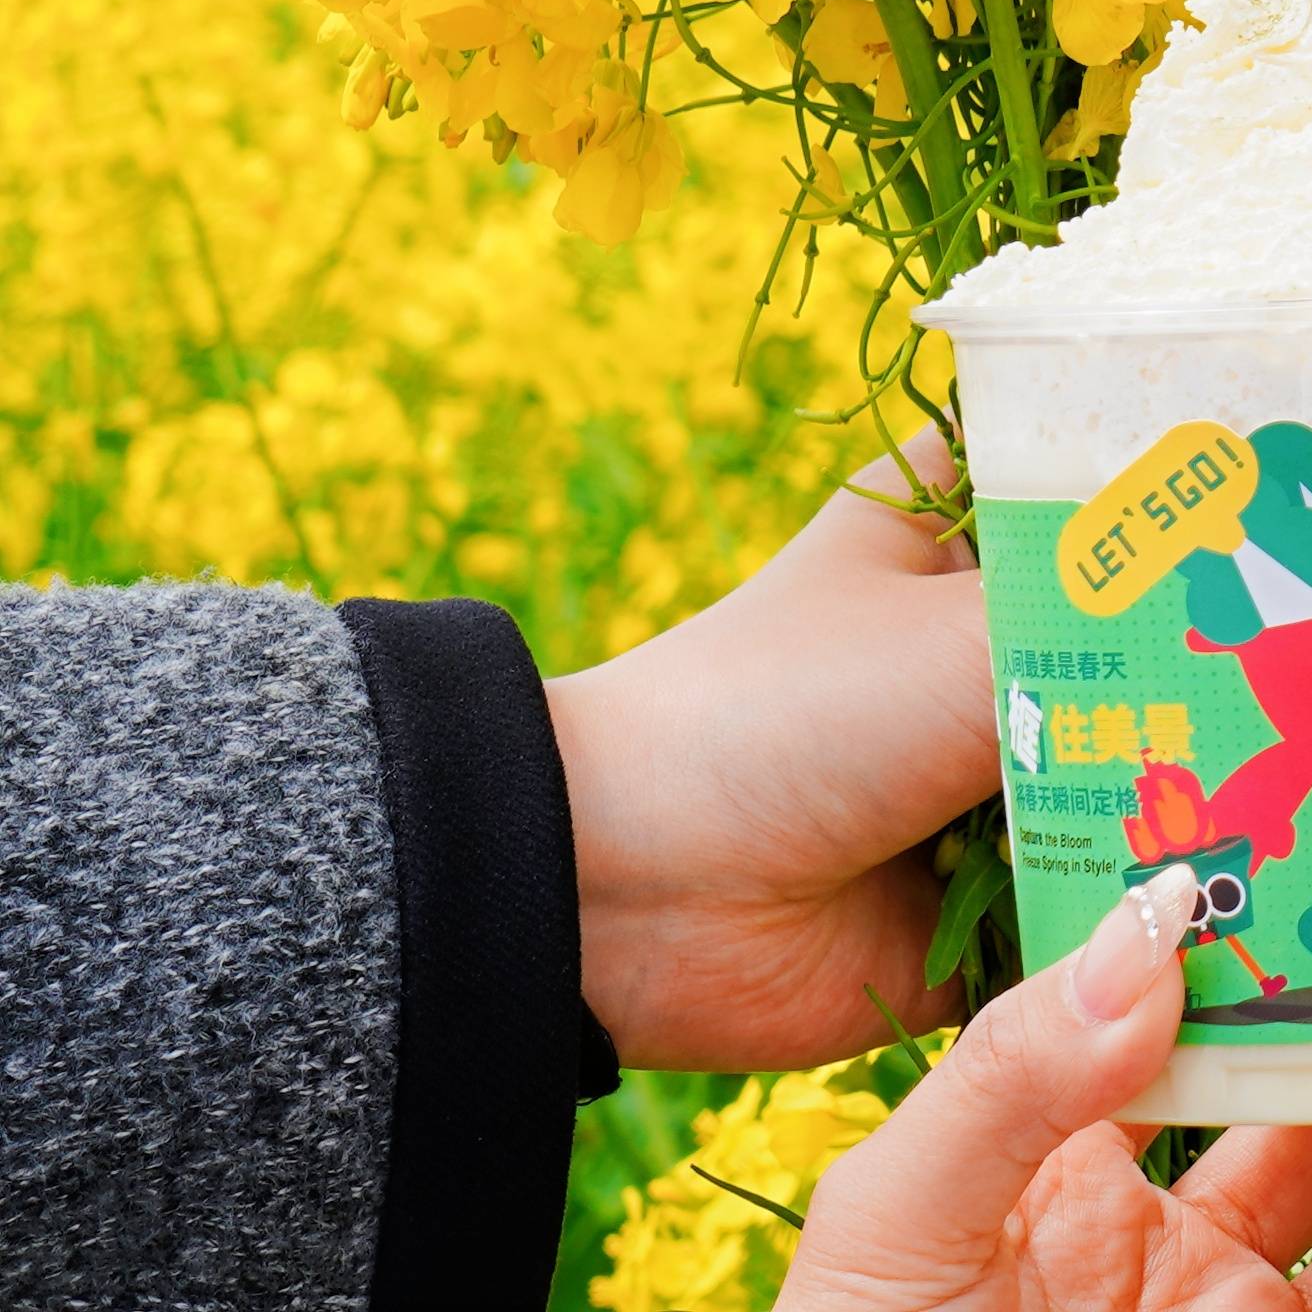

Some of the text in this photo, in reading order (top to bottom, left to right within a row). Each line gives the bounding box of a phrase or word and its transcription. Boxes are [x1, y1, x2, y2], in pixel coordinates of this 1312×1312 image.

[1076, 437, 1245, 593] LET'S GO!
[1003, 648, 1128, 681] 人间最美是春天
[1007, 678, 1196, 775] 框住美景
[1014, 781, 1140, 817] 将春天瞬间定格
[1060, 833, 1093, 849] Bloom
[1042, 855, 1069, 876] Spring
[1071, 858, 1081, 873] in
[1084, 857, 1117, 878] Style!
